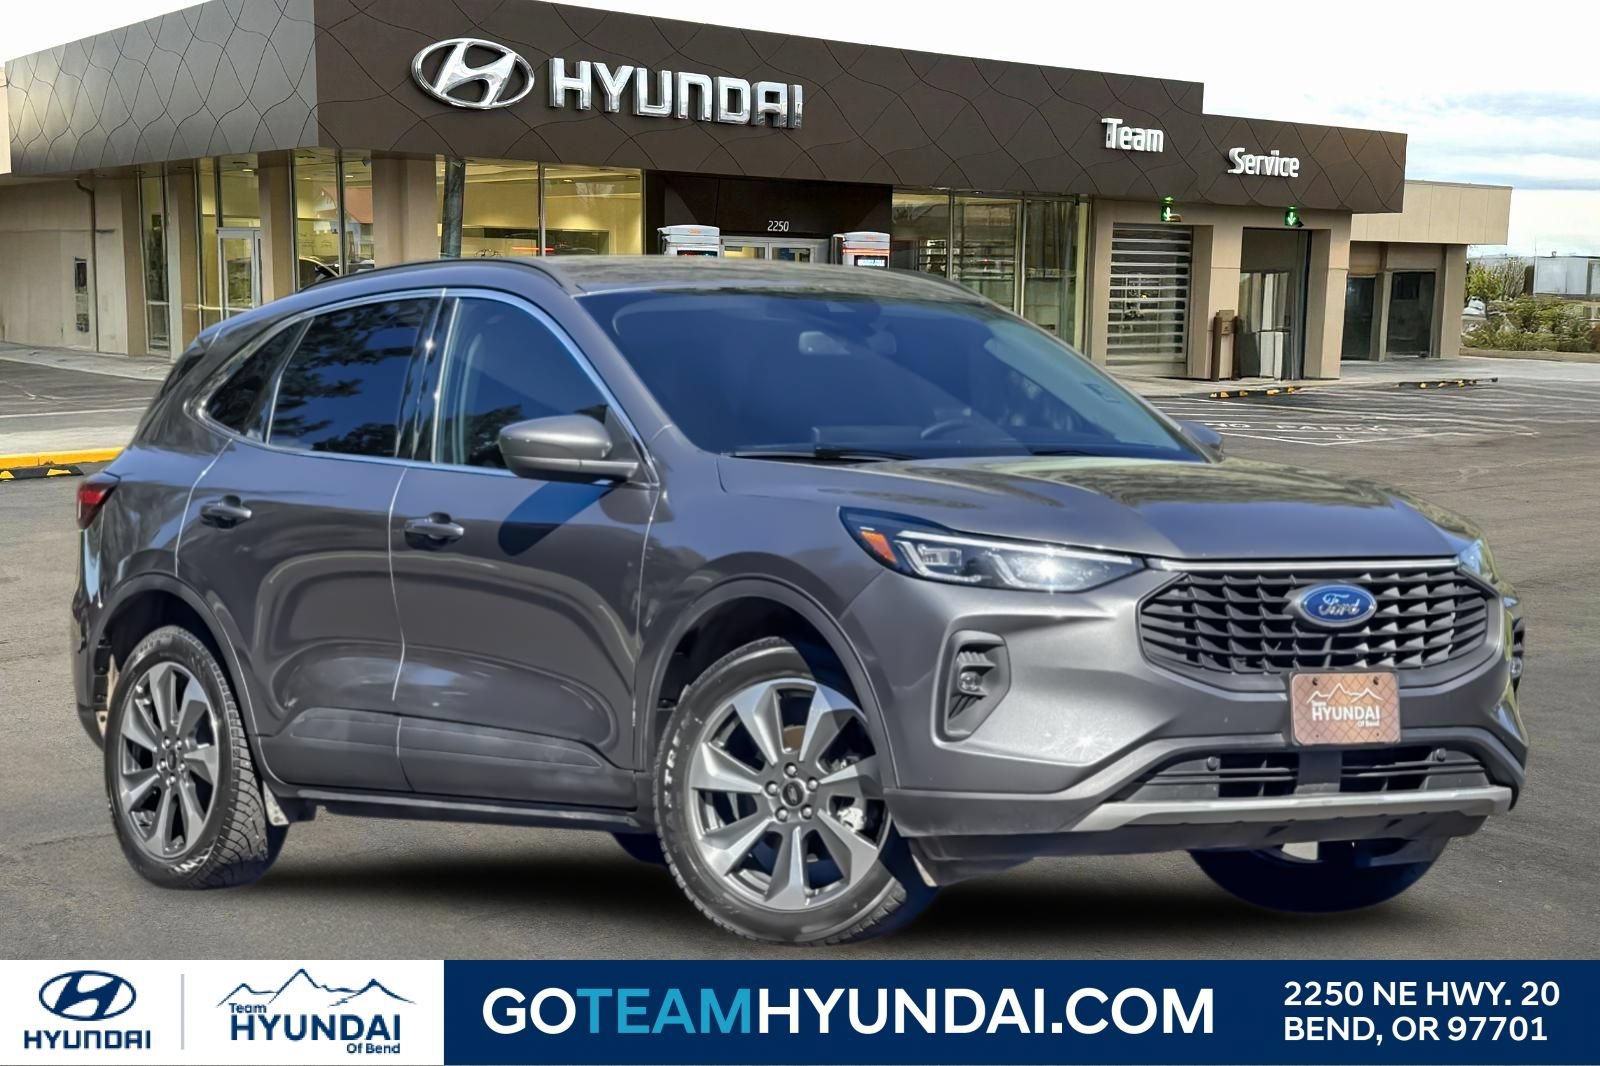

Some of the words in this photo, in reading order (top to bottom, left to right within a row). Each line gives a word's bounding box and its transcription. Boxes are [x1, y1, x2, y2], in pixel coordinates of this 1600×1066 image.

[549, 57, 802, 129] HYUNDAI
[1101, 118, 1164, 152] Team
[1227, 147, 1300, 177] Service
[767, 220, 789, 232] 2250
[1318, 592, 1361, 616] Ford
[1312, 705, 1380, 721] HYUNDAI
